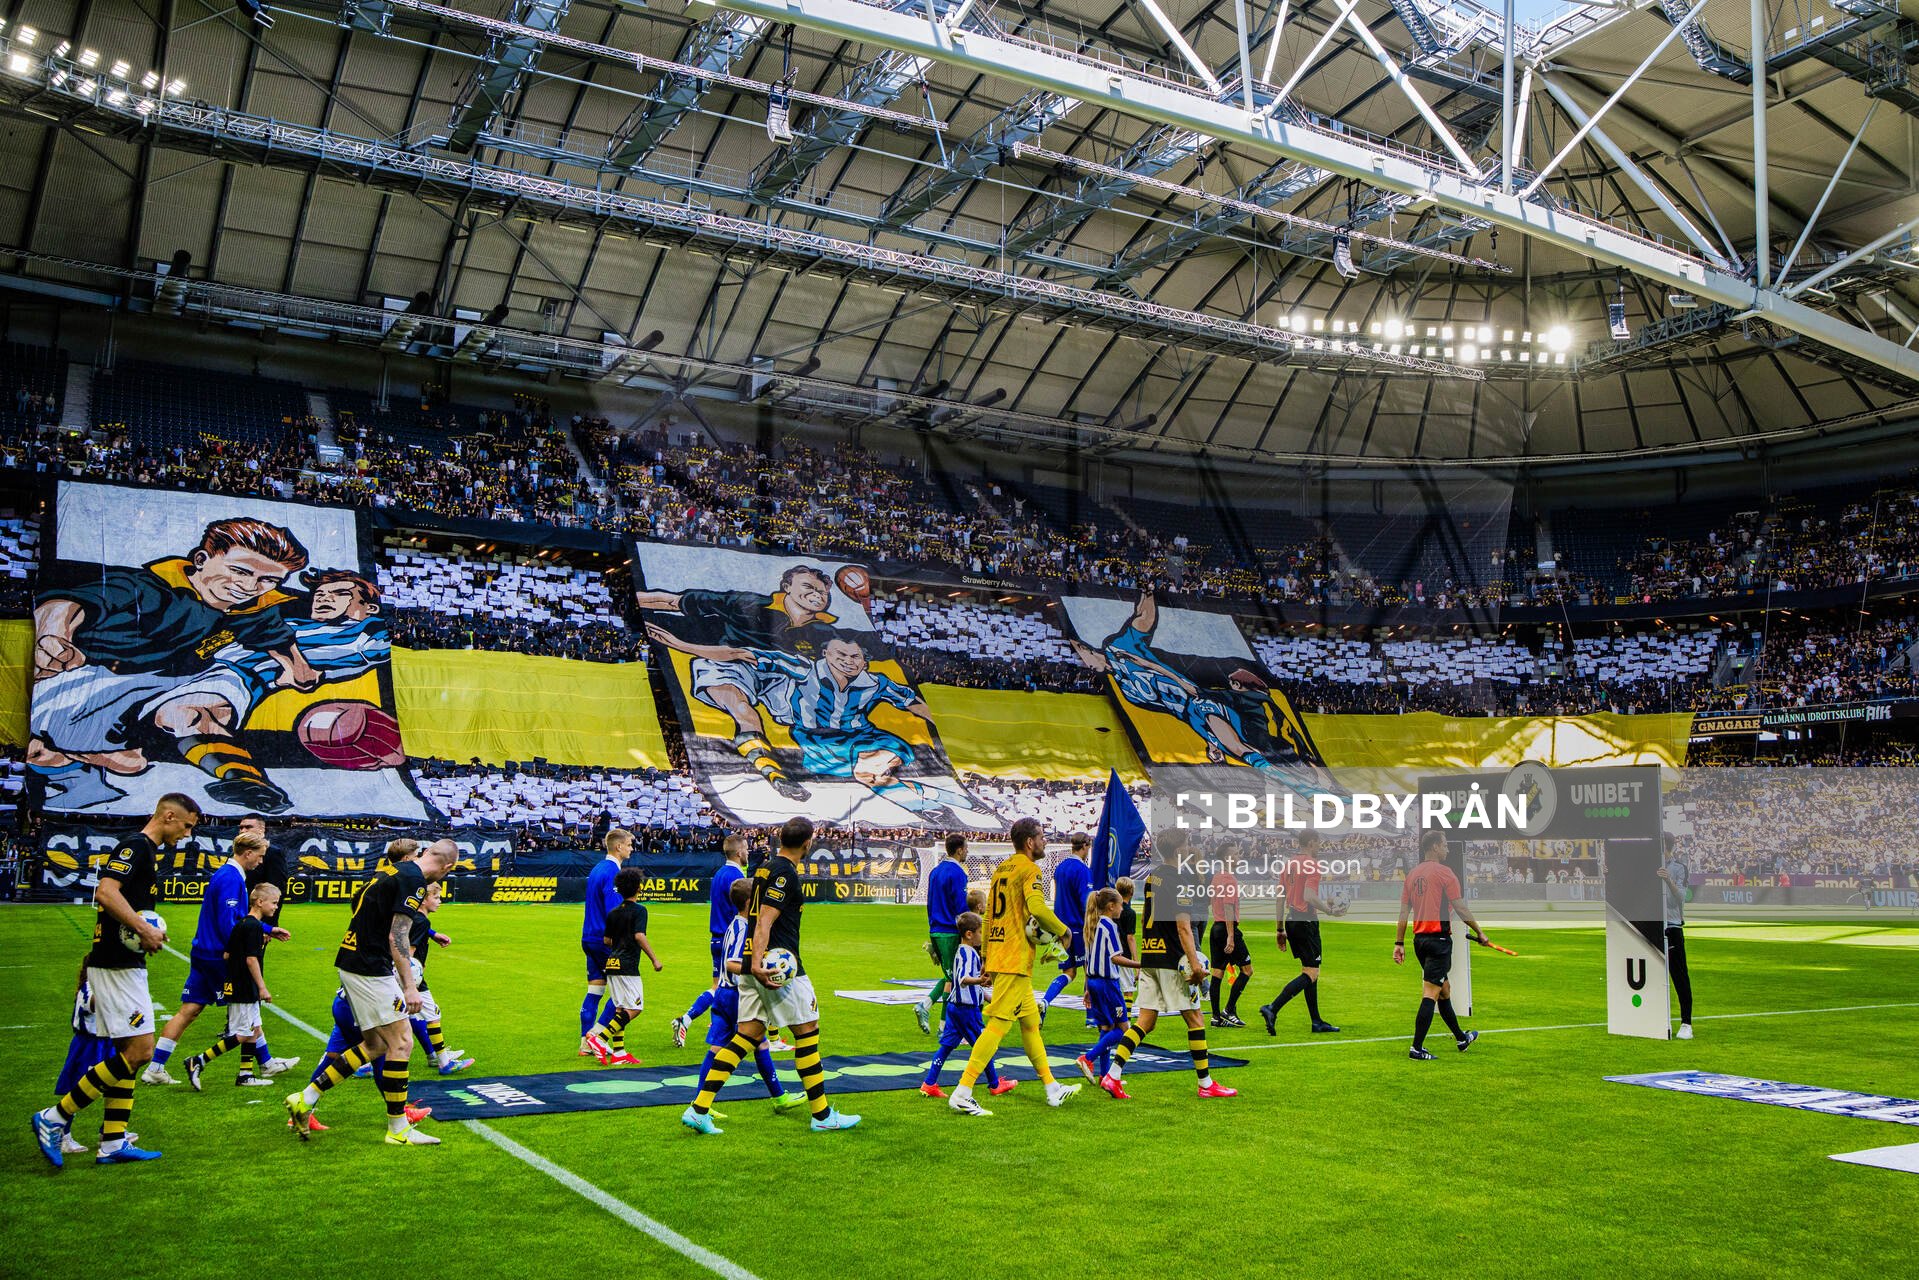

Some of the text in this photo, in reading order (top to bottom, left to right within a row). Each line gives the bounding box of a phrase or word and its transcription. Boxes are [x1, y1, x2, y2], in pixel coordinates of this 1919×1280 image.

[962, 575, 1000, 588] Strawberry
[1763, 711, 1806, 726] ALLMÄNNA
[1866, 705, 1892, 722] AIK
[1698, 719, 1761, 732] GNAGARE
[1571, 781, 1643, 804] UNIBET
[164, 877, 210, 895] ther
[493, 876, 558, 887] BRUNNA
[670, 878, 699, 891] TAK
[1705, 876, 1775, 887] amoabel
[1626, 957, 1646, 990] U
